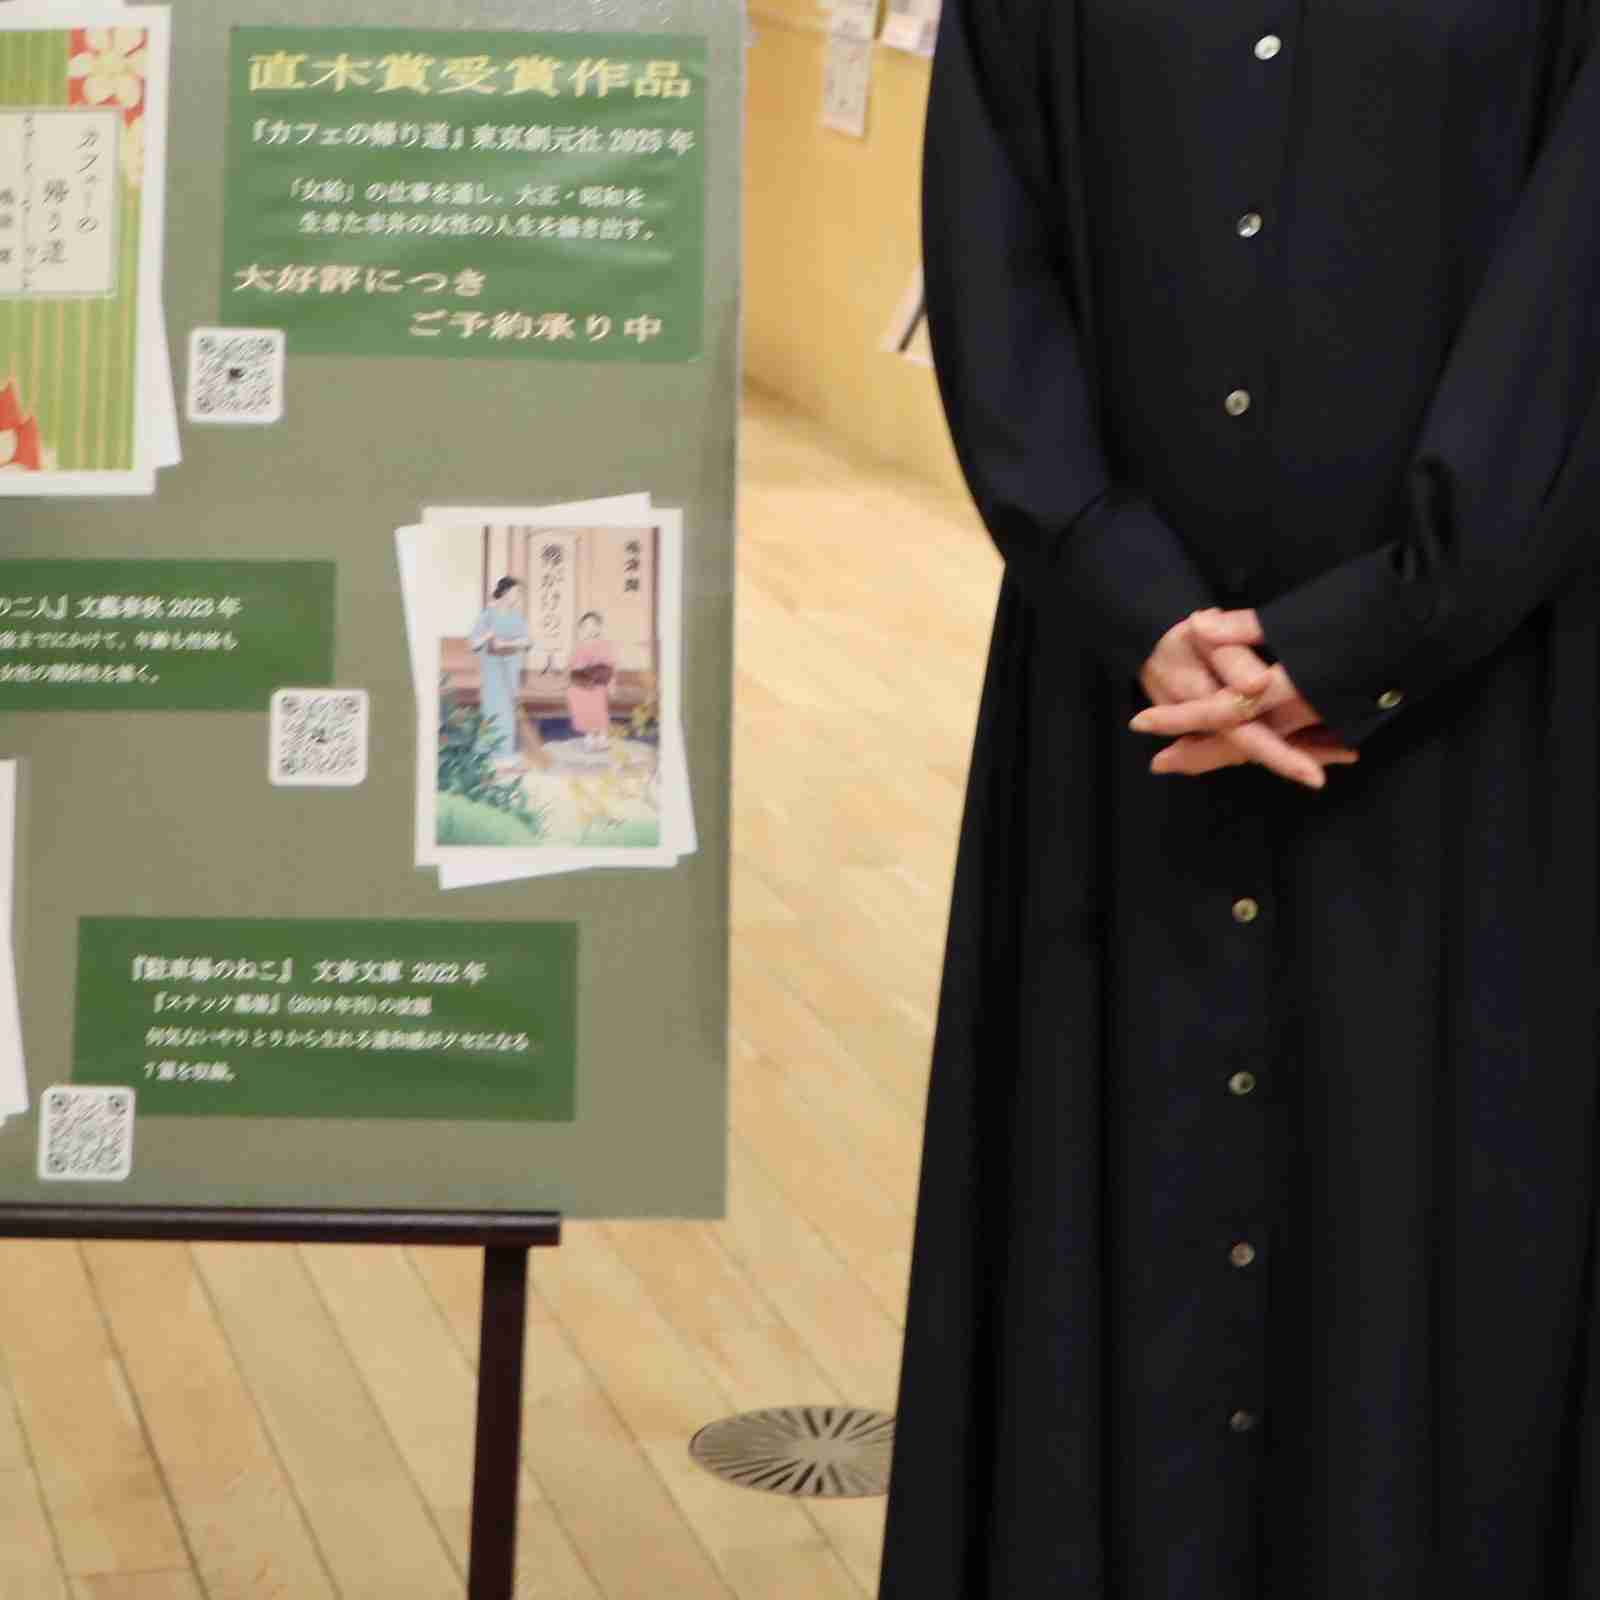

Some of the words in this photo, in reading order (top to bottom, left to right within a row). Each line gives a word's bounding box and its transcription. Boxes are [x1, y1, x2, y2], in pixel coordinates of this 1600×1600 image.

[248, 50, 692, 99] 直木賞受賞作品
[233, 262, 486, 298] 大好評につき
[407, 307, 663, 344] ご予約承り中
